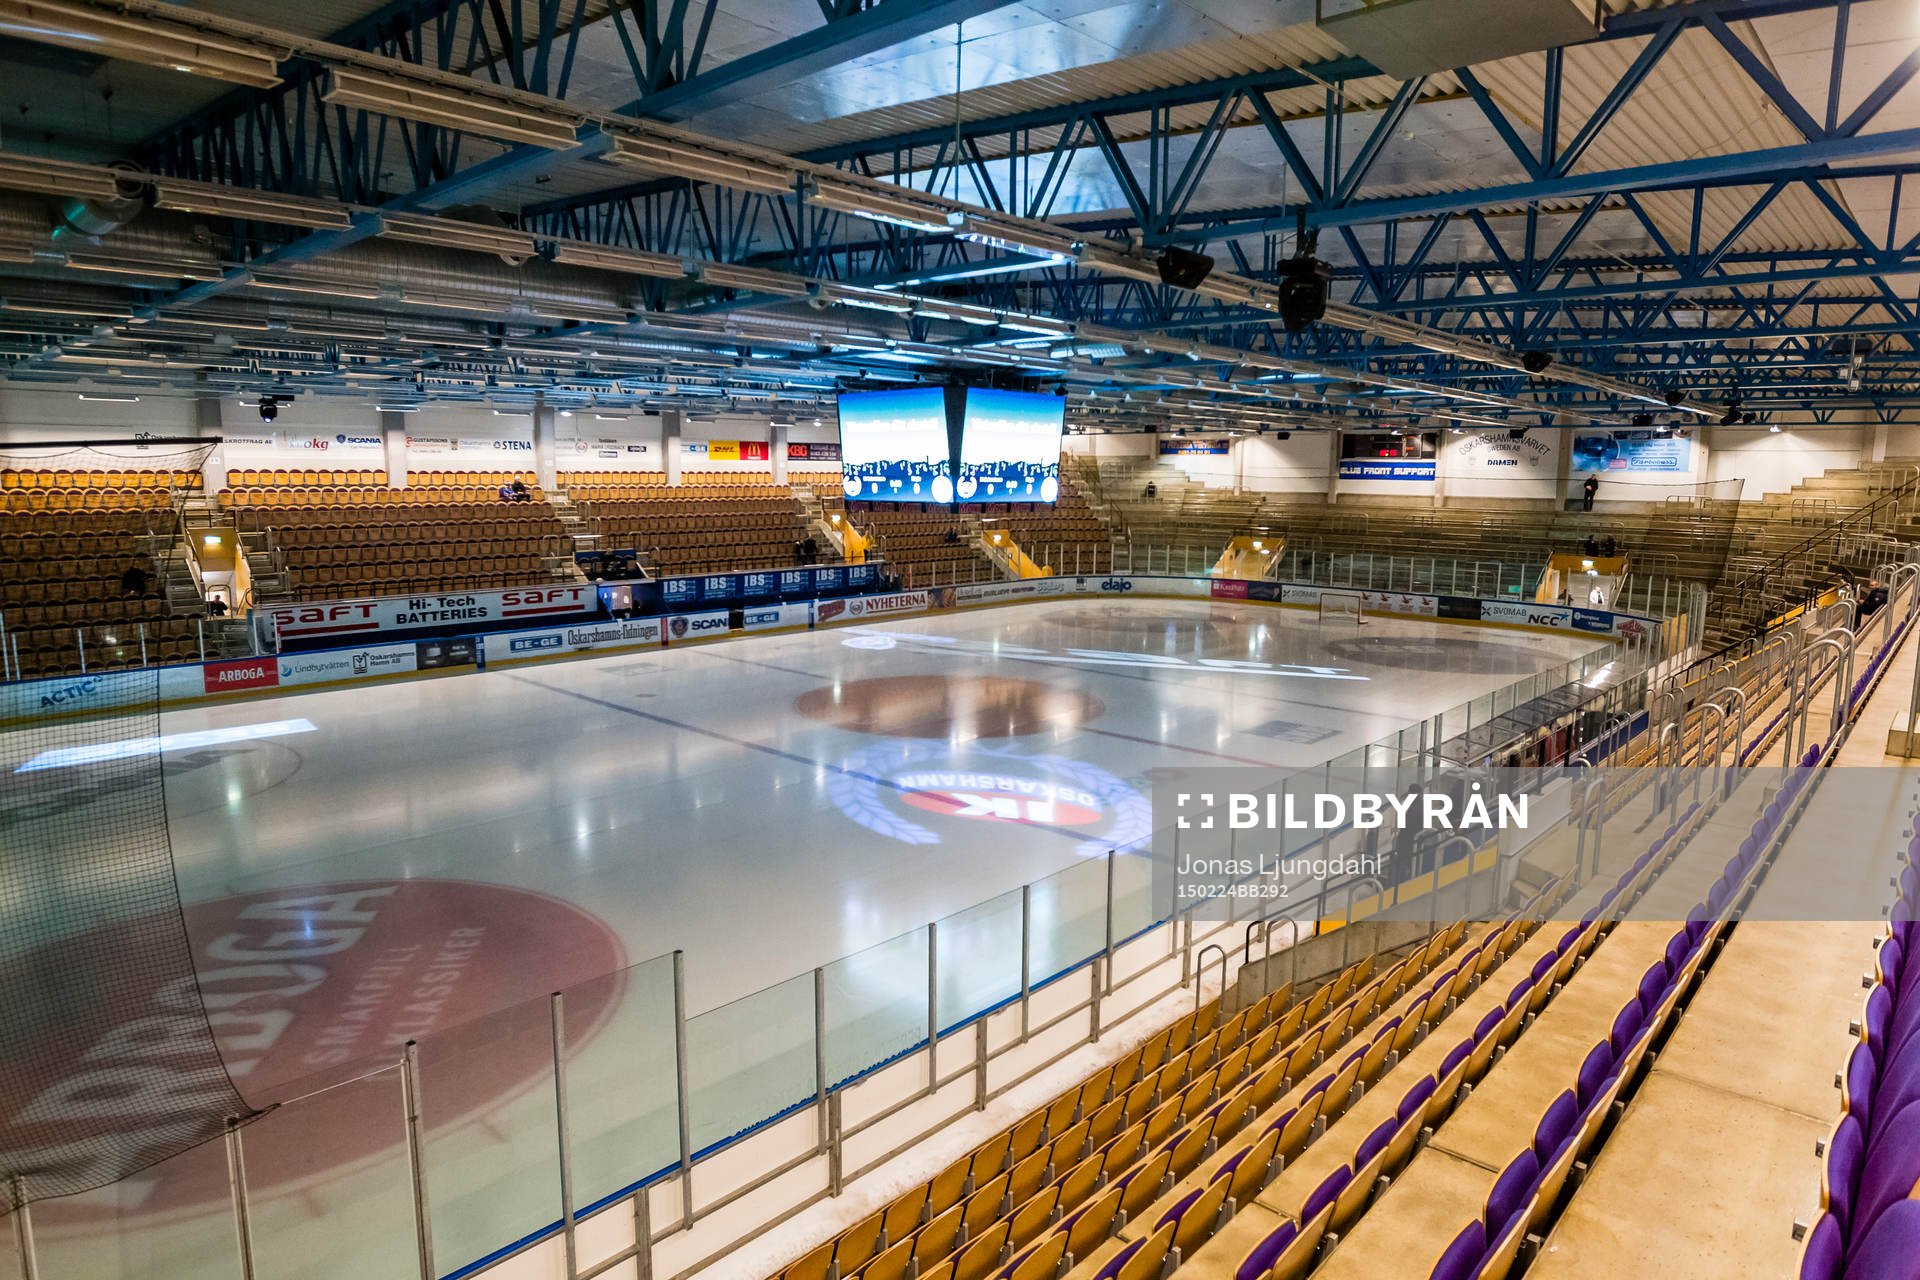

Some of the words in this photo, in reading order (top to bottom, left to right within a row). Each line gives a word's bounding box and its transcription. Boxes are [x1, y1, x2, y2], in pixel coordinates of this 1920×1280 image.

[304, 438, 329, 451] okg
[502, 440, 532, 450] STENA
[1363, 467, 1392, 475] FRONT
[1393, 467, 1435, 476] SUPPORT
[781, 571, 801, 584] IBS
[815, 569, 835, 581] IBS
[849, 566, 867, 578] IBS
[663, 579, 687, 594] IBS
[705, 577, 727, 590] IBS
[744, 574, 765, 587] IBS
[1101, 578, 1132, 593] elajo
[438, 595, 476, 608] Tech
[865, 593, 926, 611] NYHETERNA
[396, 607, 488, 625] BATTERIES
[1493, 606, 1527, 617] SVOMAB
[1528, 614, 1560, 626] NCC
[515, 637, 559, 649] BE-GE
[370, 651, 415, 661] Oskarshamns
[370, 659, 390, 667] Hamn
[218, 667, 265, 683] ARBOGA
[950, 792, 1056, 823] IK
